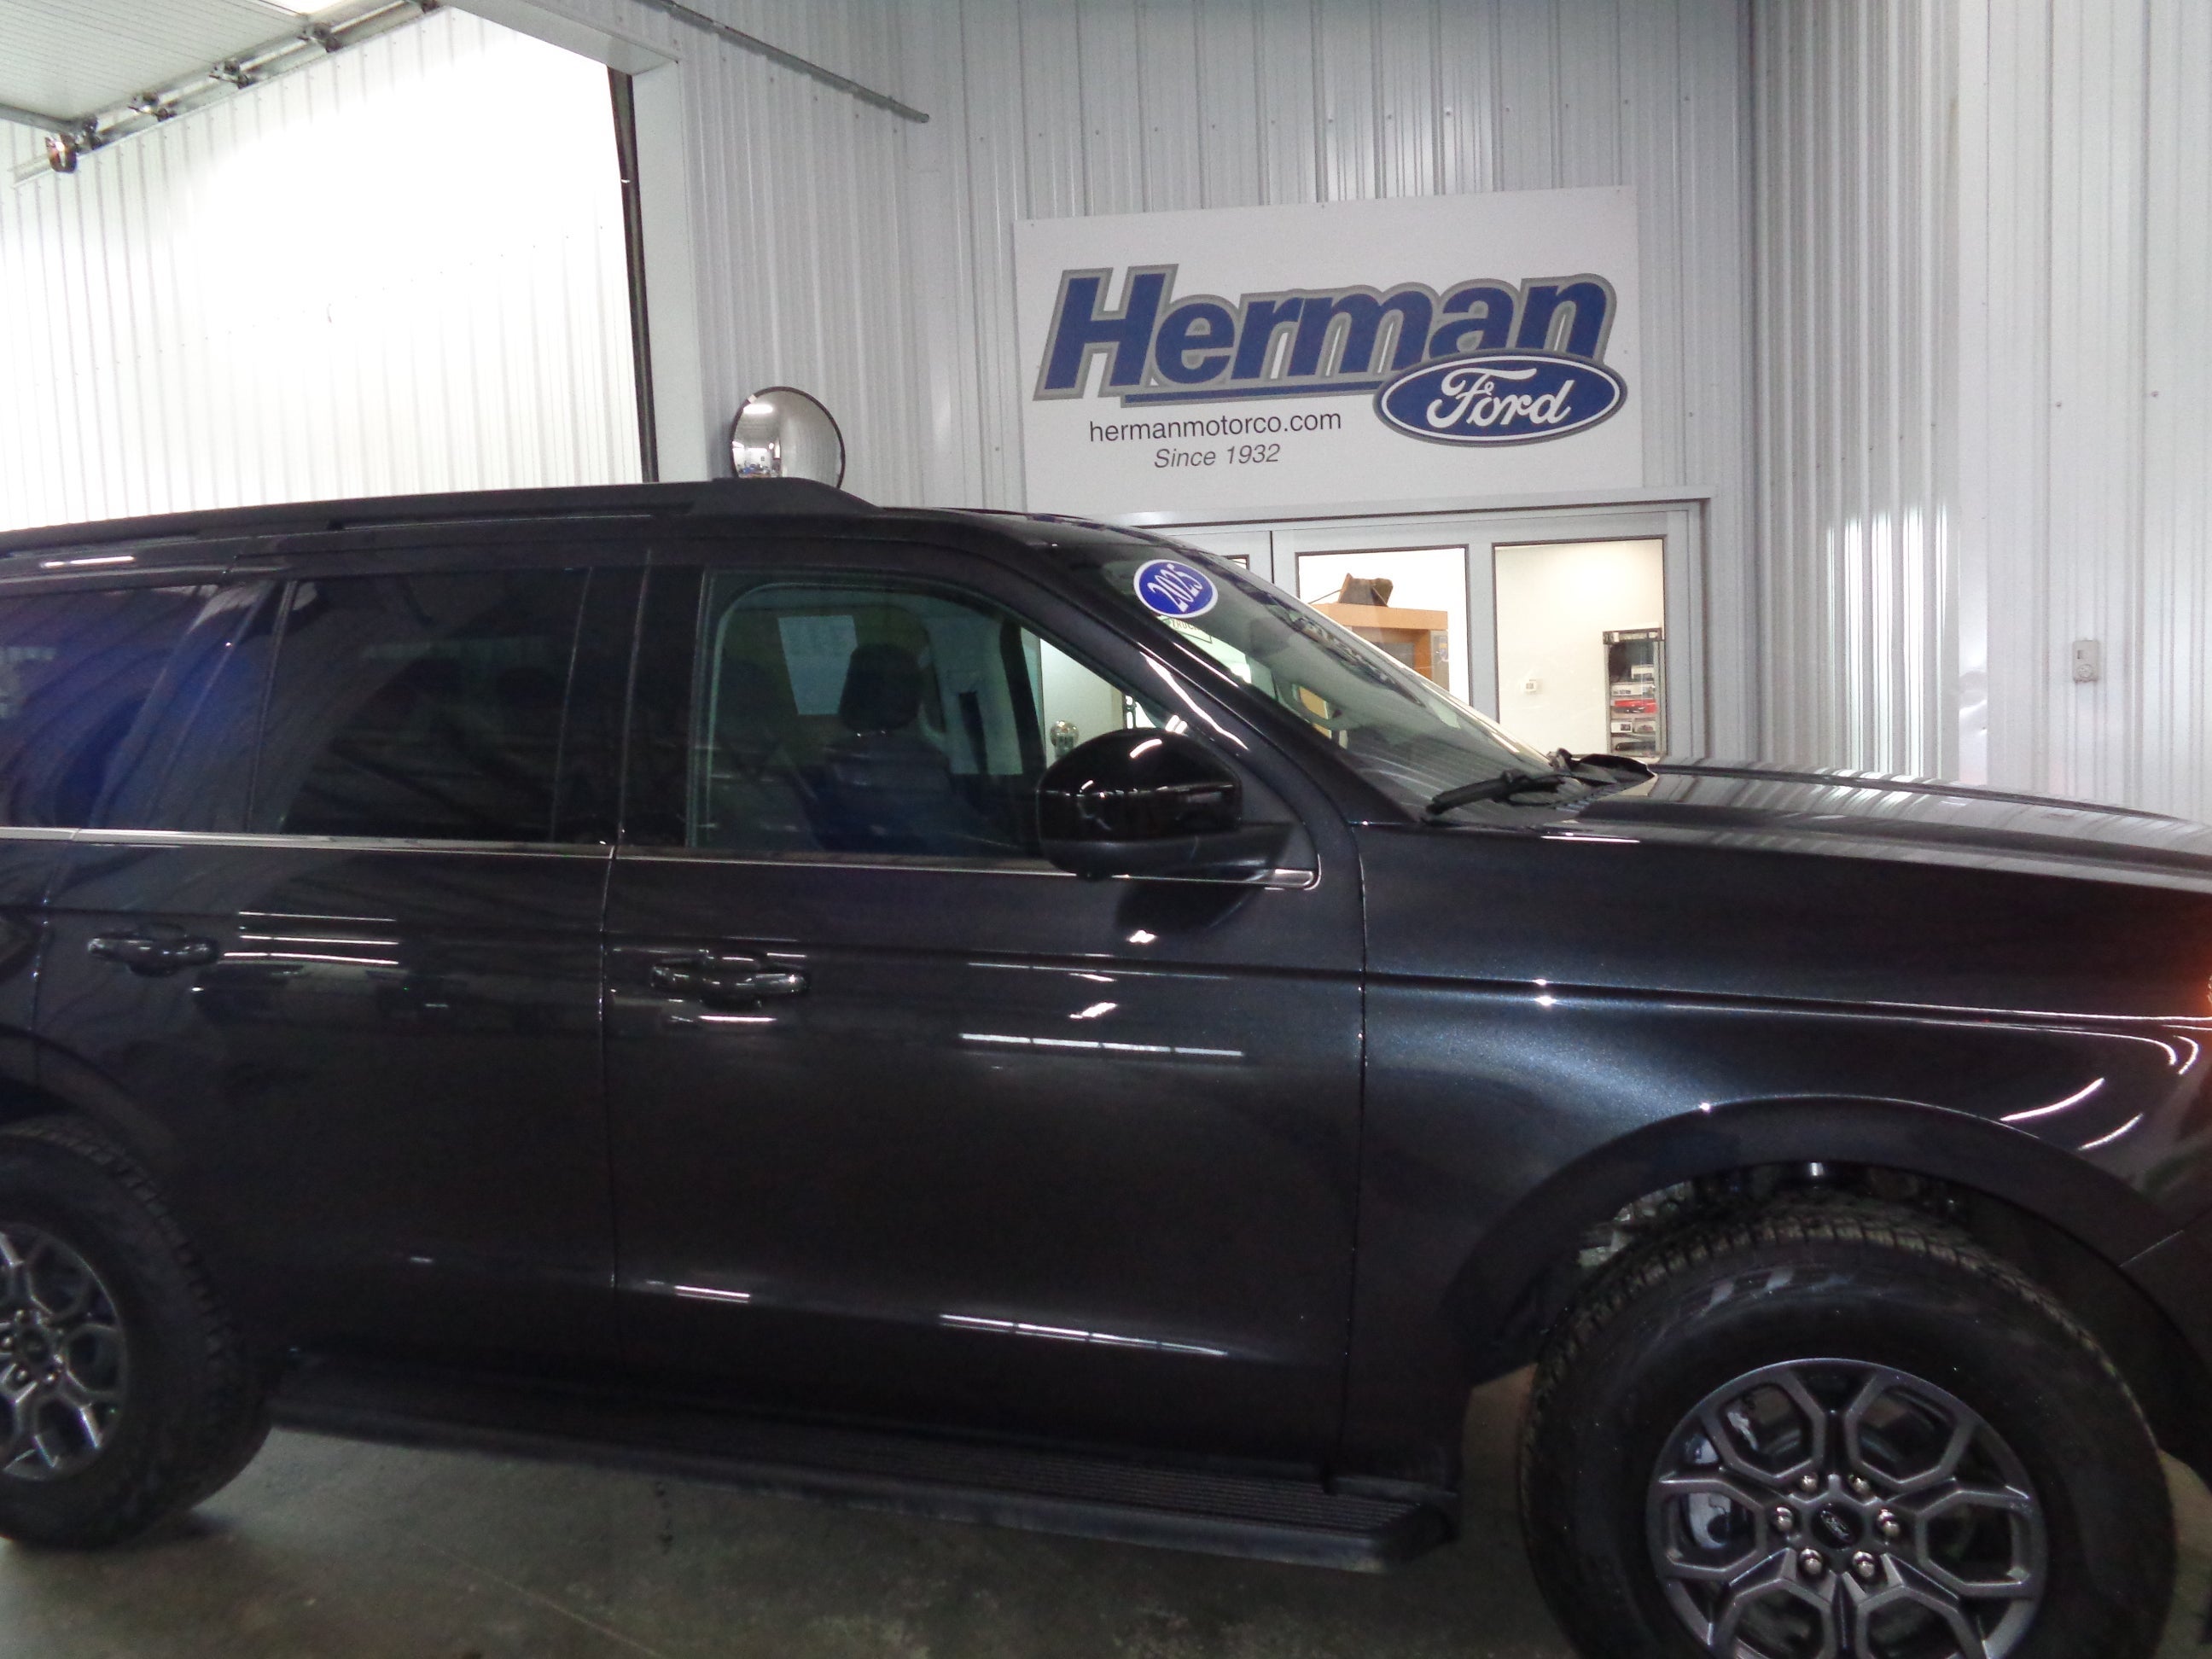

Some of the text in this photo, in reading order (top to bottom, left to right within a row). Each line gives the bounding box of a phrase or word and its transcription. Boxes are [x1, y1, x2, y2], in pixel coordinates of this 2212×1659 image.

[1033, 264, 1617, 401] Herman
[1426, 367, 1575, 429] Ford
[1089, 411, 1342, 443] hermanmotorco.com
[1154, 444, 1281, 469] Since 1932
[1146, 562, 1203, 613] 2025
[1172, 619, 1198, 631] TRUC
